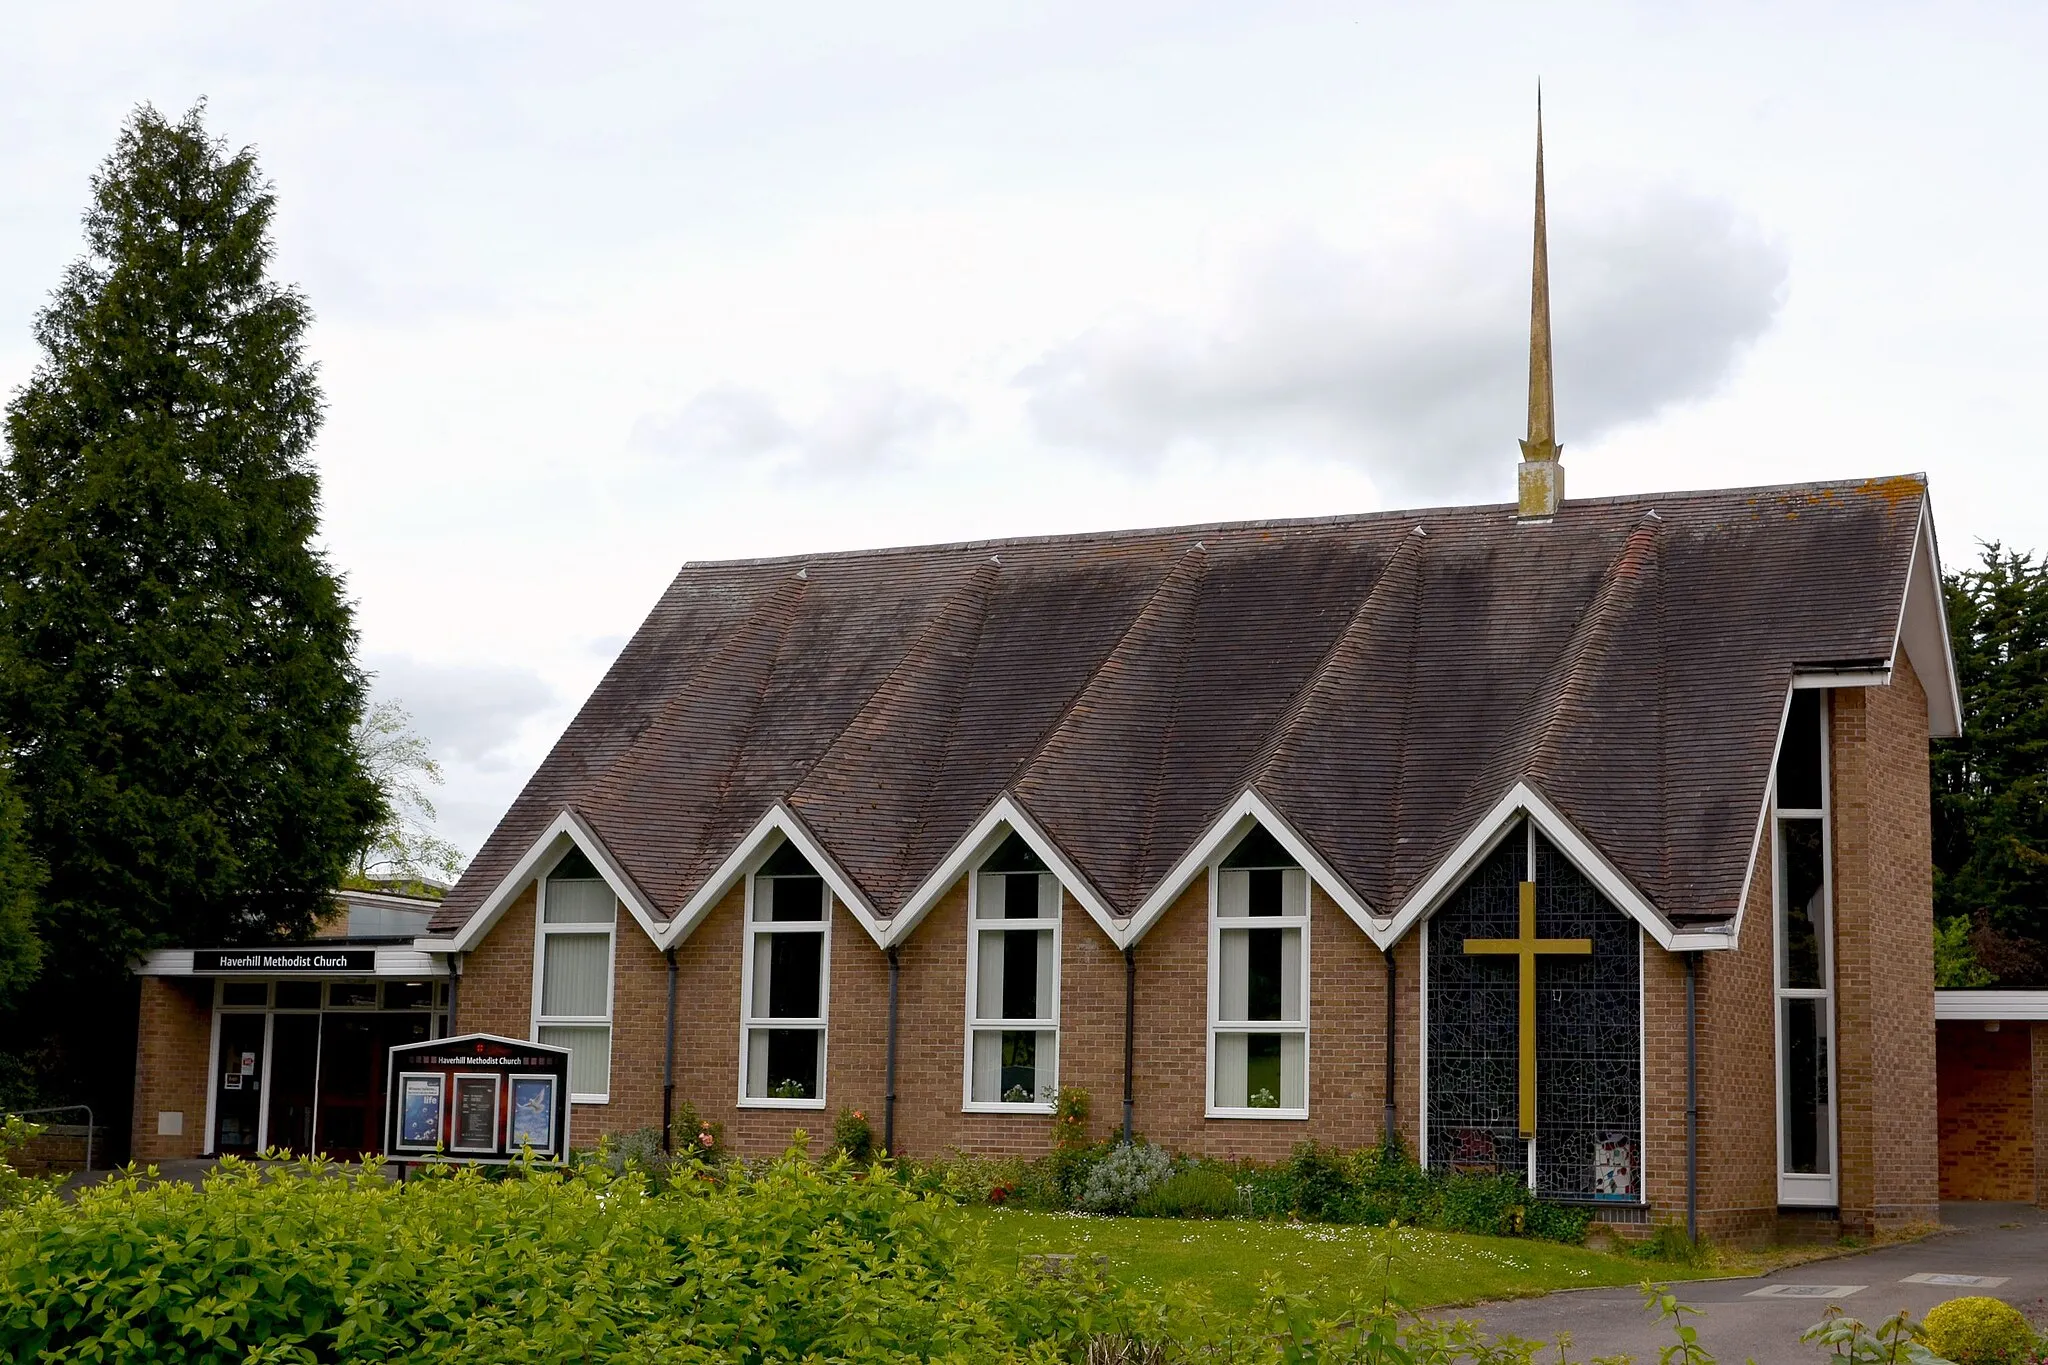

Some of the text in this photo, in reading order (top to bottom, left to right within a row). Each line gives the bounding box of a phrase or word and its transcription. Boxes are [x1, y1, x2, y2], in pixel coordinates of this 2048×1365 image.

[220, 955, 347, 967] Haverhill Methodist Church
[438, 1056, 522, 1065] Haverhill Methodist Church
[423, 1095, 437, 1105] life
